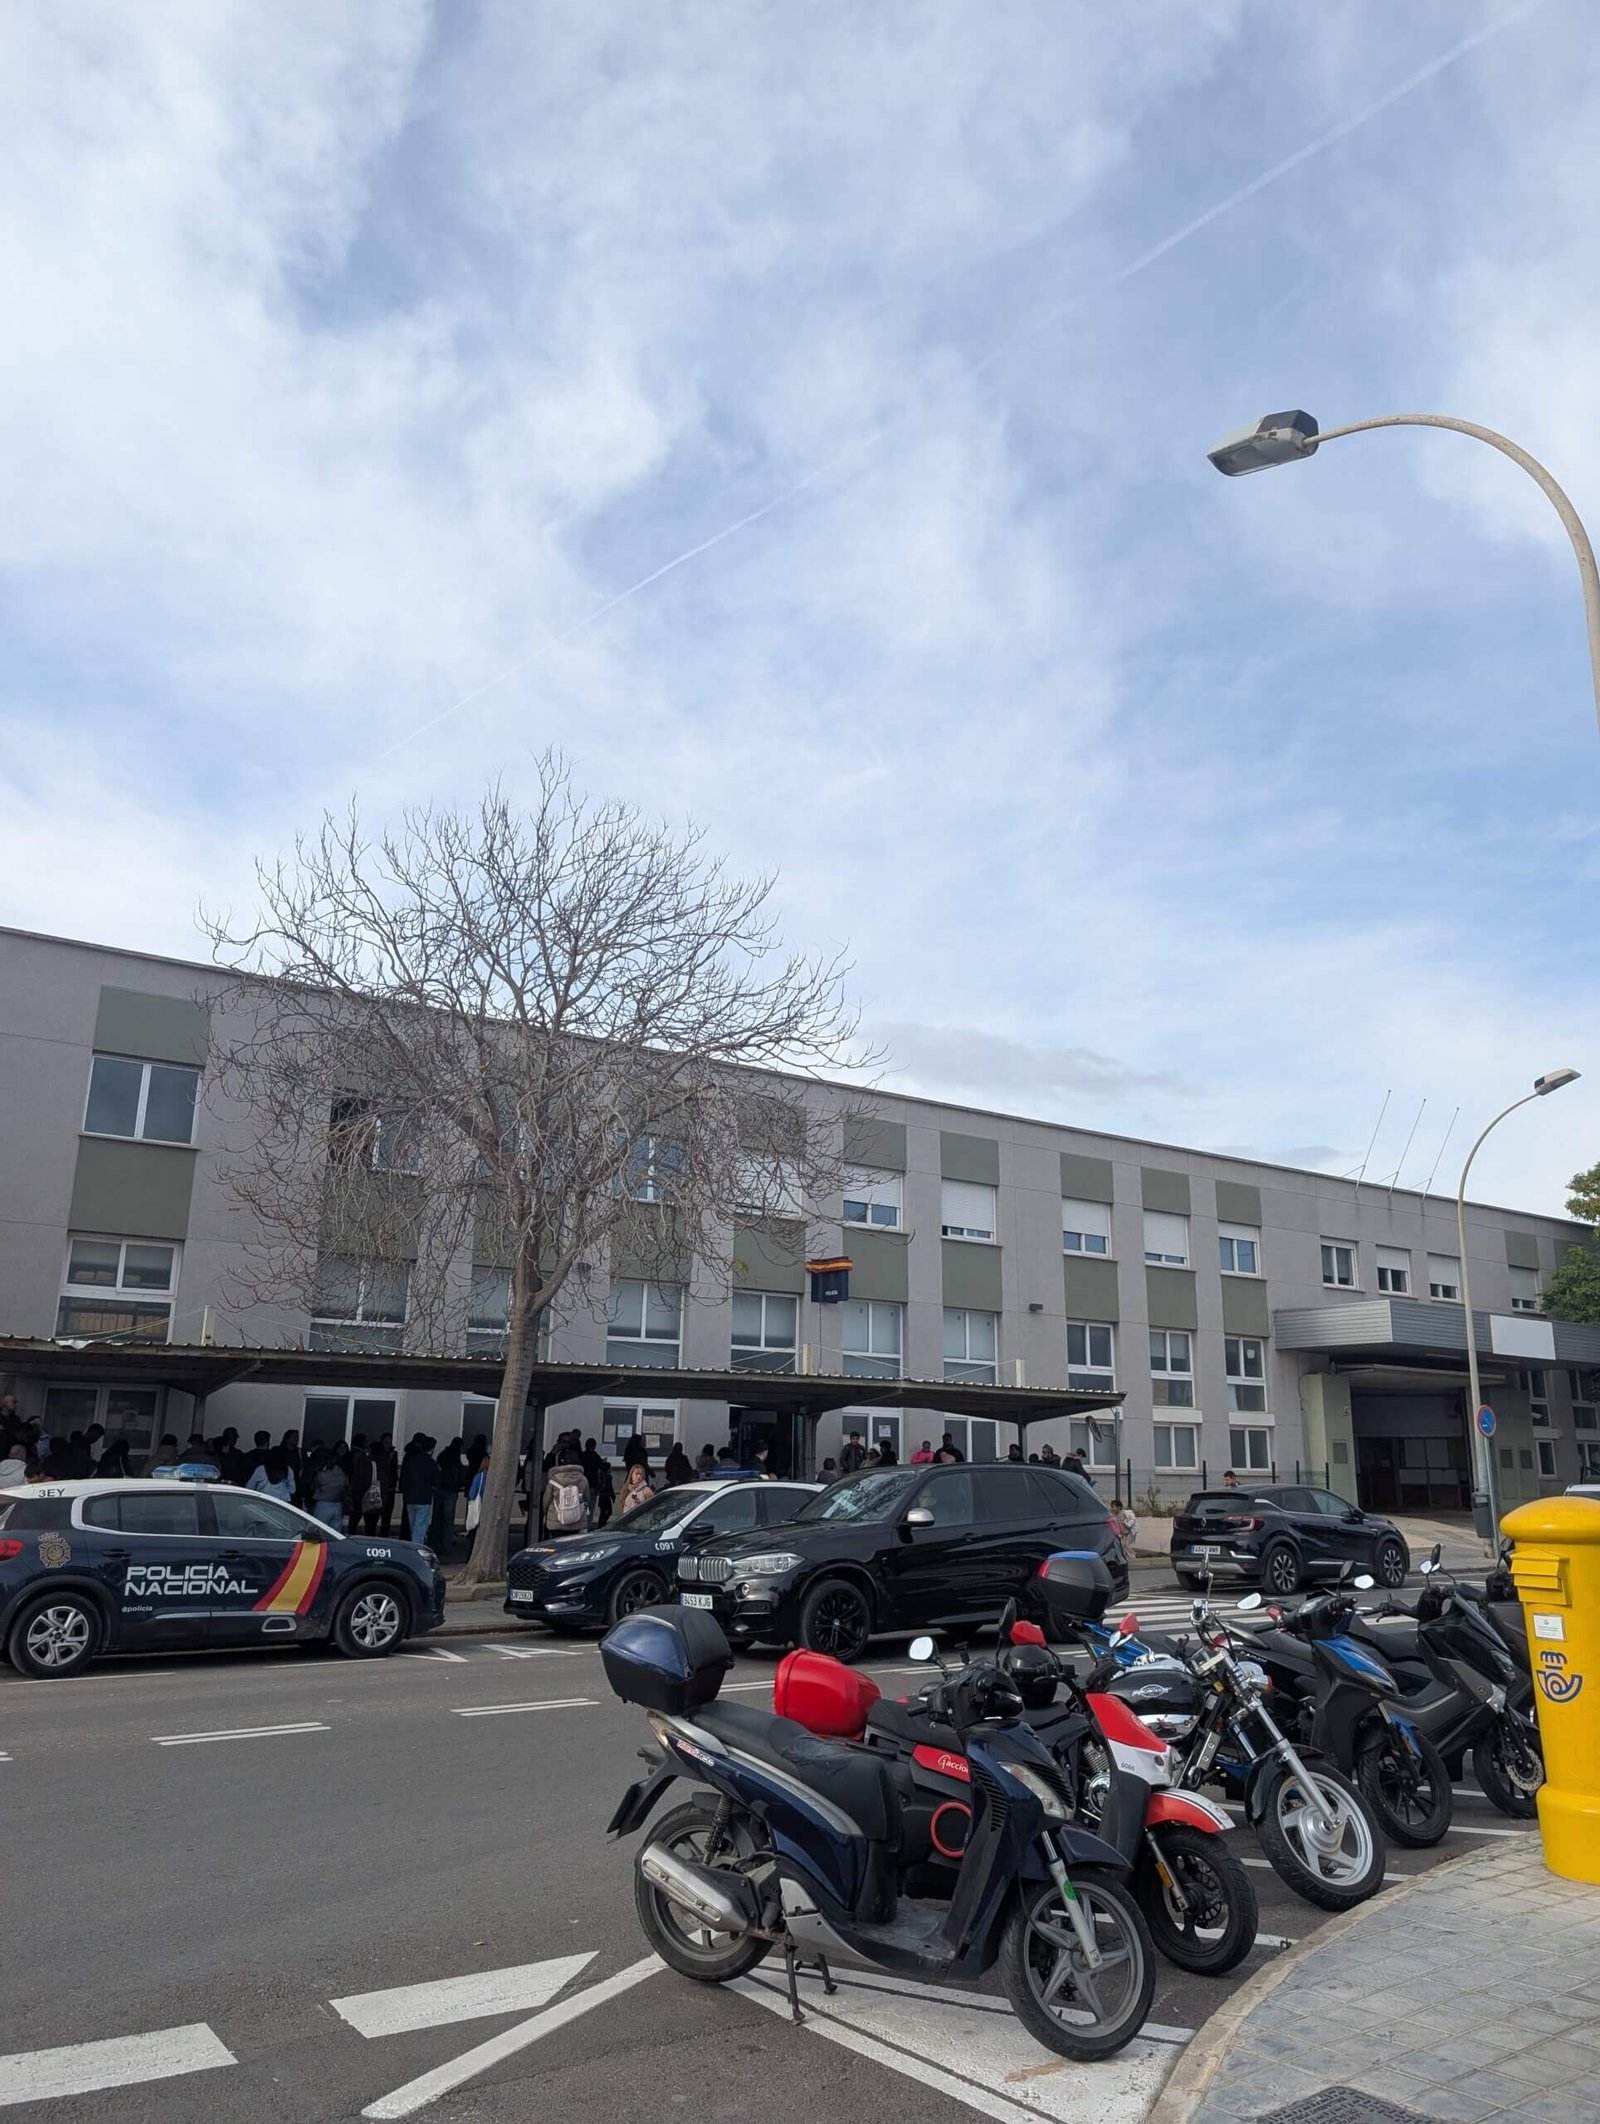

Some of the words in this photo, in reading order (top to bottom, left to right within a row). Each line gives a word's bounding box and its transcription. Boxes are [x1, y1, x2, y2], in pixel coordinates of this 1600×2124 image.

[38, 1488, 66, 1498] 3EY
[660, 1541, 675, 1551] 091
[371, 1548, 391, 1558] 091
[126, 1562, 229, 1580] POLICÍA
[124, 1580, 258, 1596] NACIONAL
